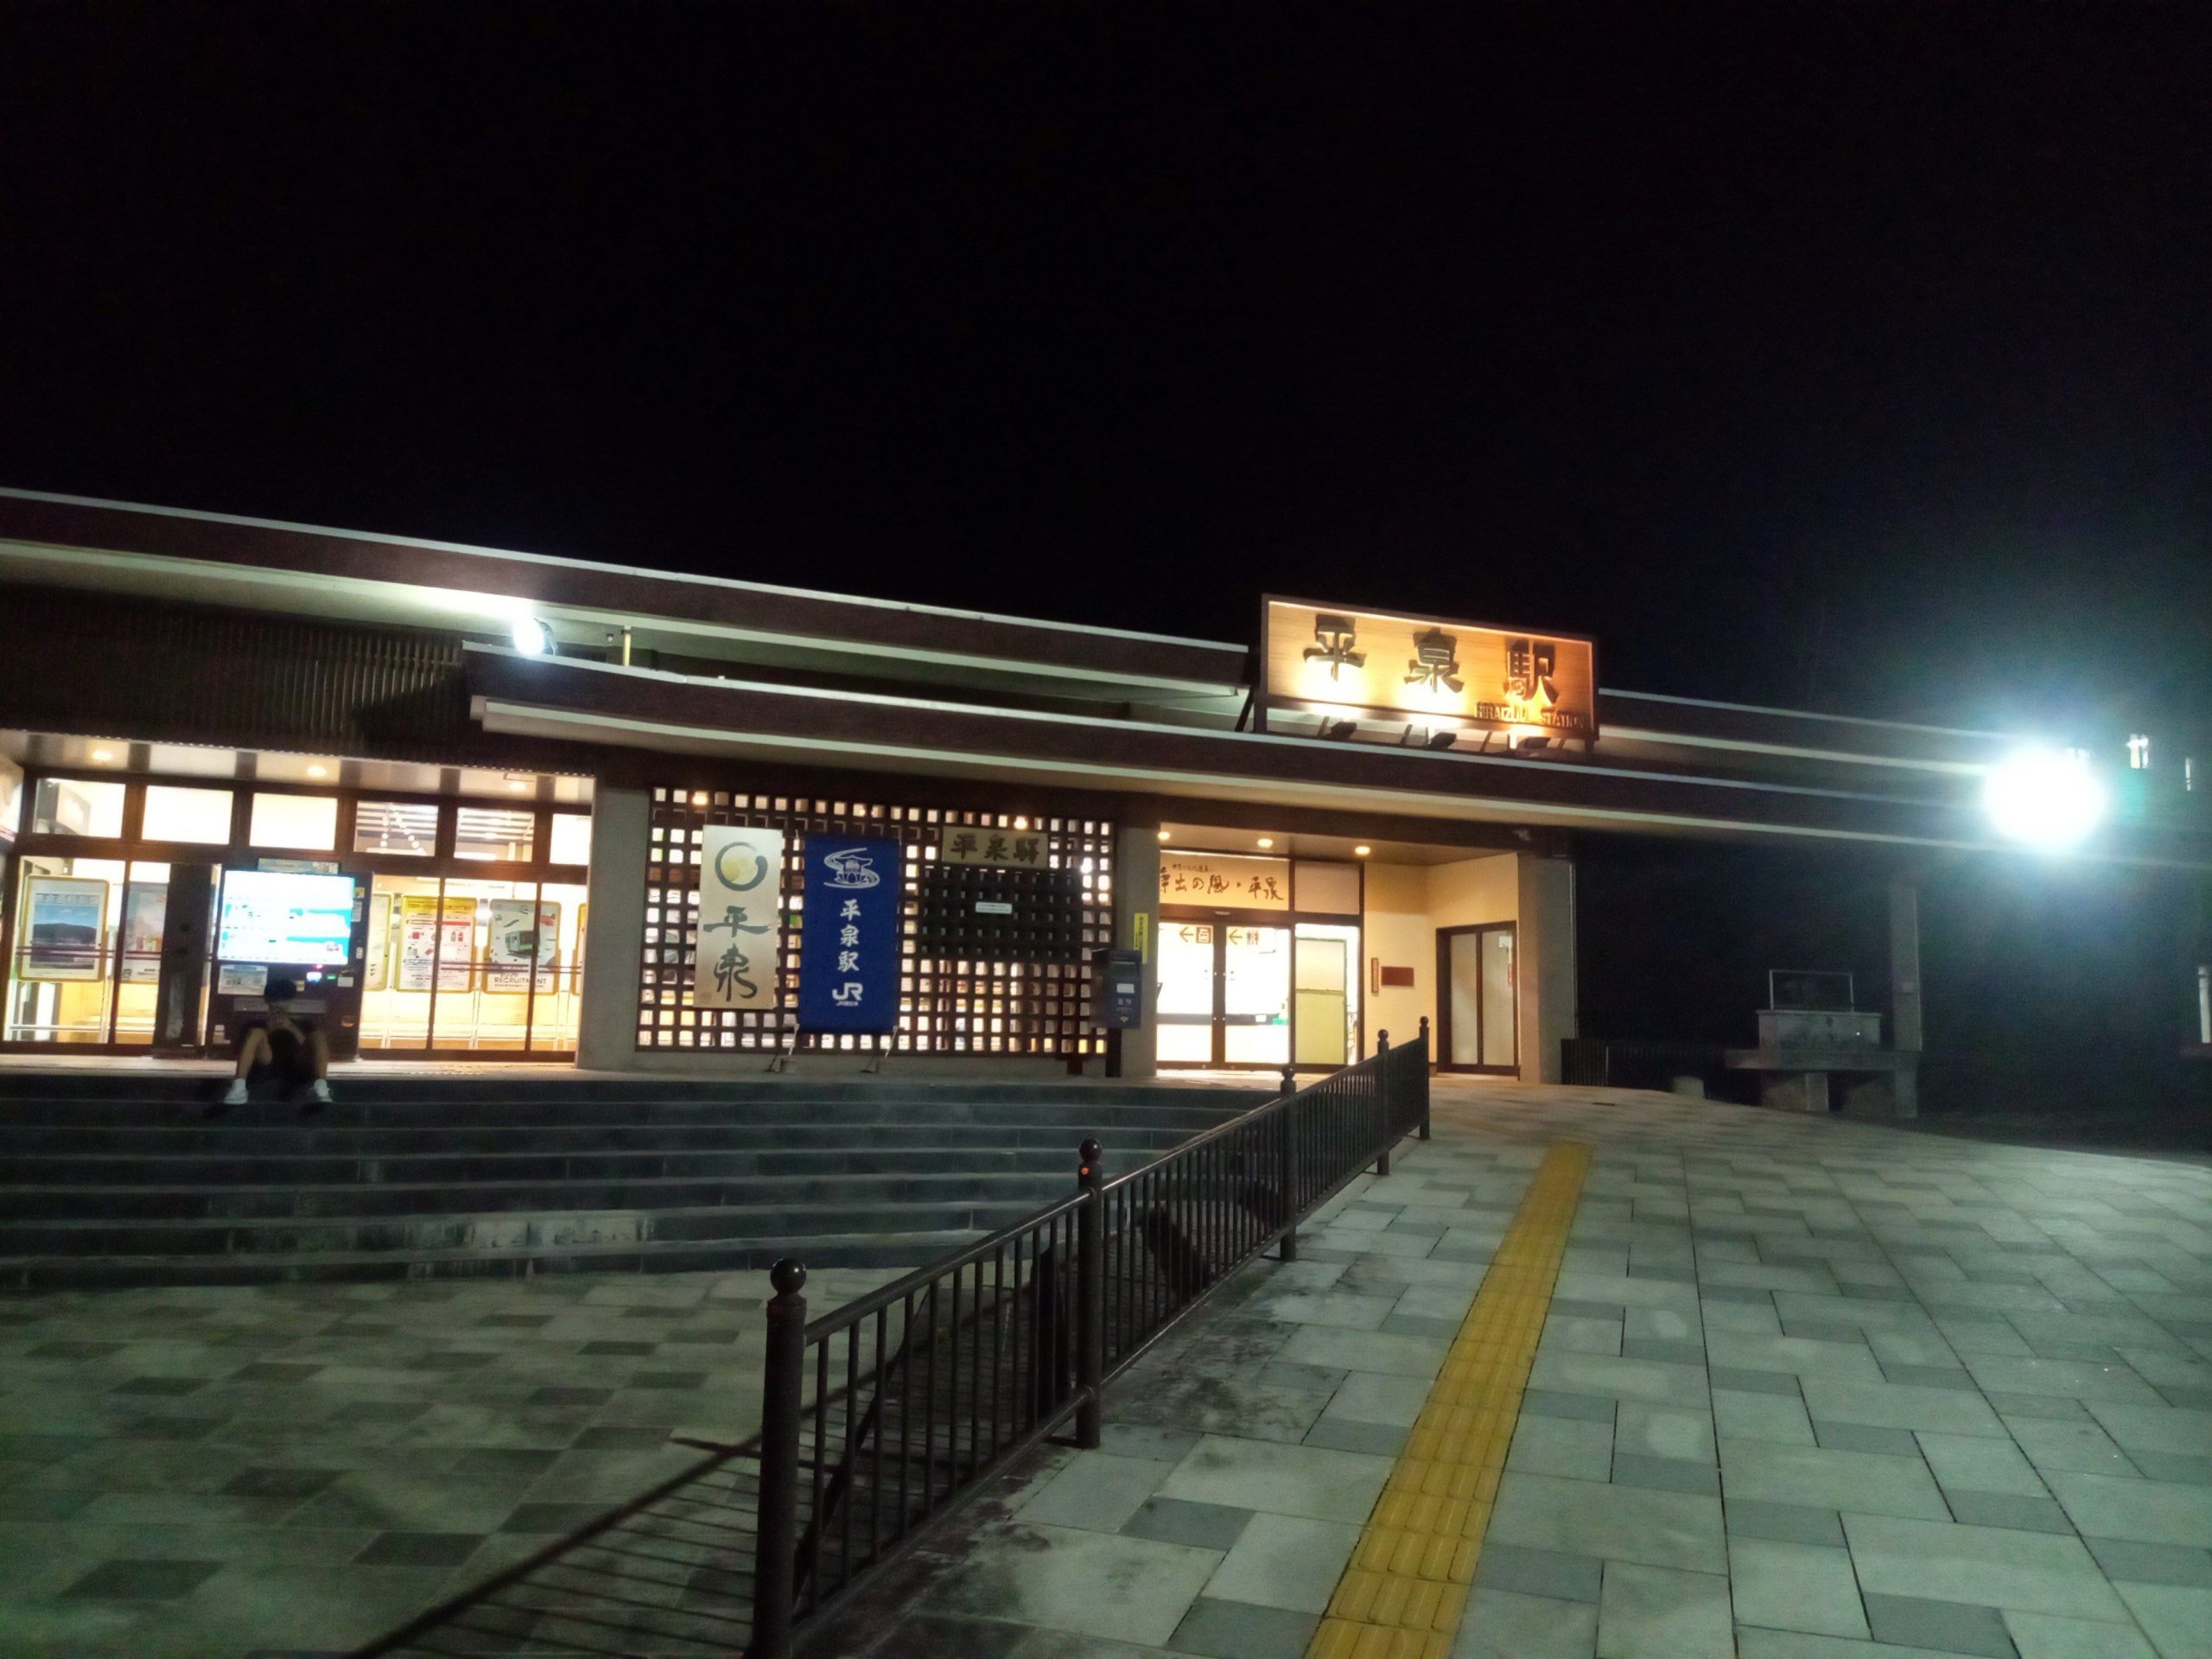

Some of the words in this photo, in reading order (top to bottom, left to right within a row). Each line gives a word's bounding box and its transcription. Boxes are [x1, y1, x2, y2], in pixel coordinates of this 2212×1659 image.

[1303, 613, 1560, 707] 平泉駅
[1474, 702, 1530, 723] HIRAIZUM
[702, 905, 772, 1002] 平泉
[837, 899, 861, 973] 平泉駅
[493, 976, 547, 985] RECRUITNT
[832, 982, 863, 1001] JR
